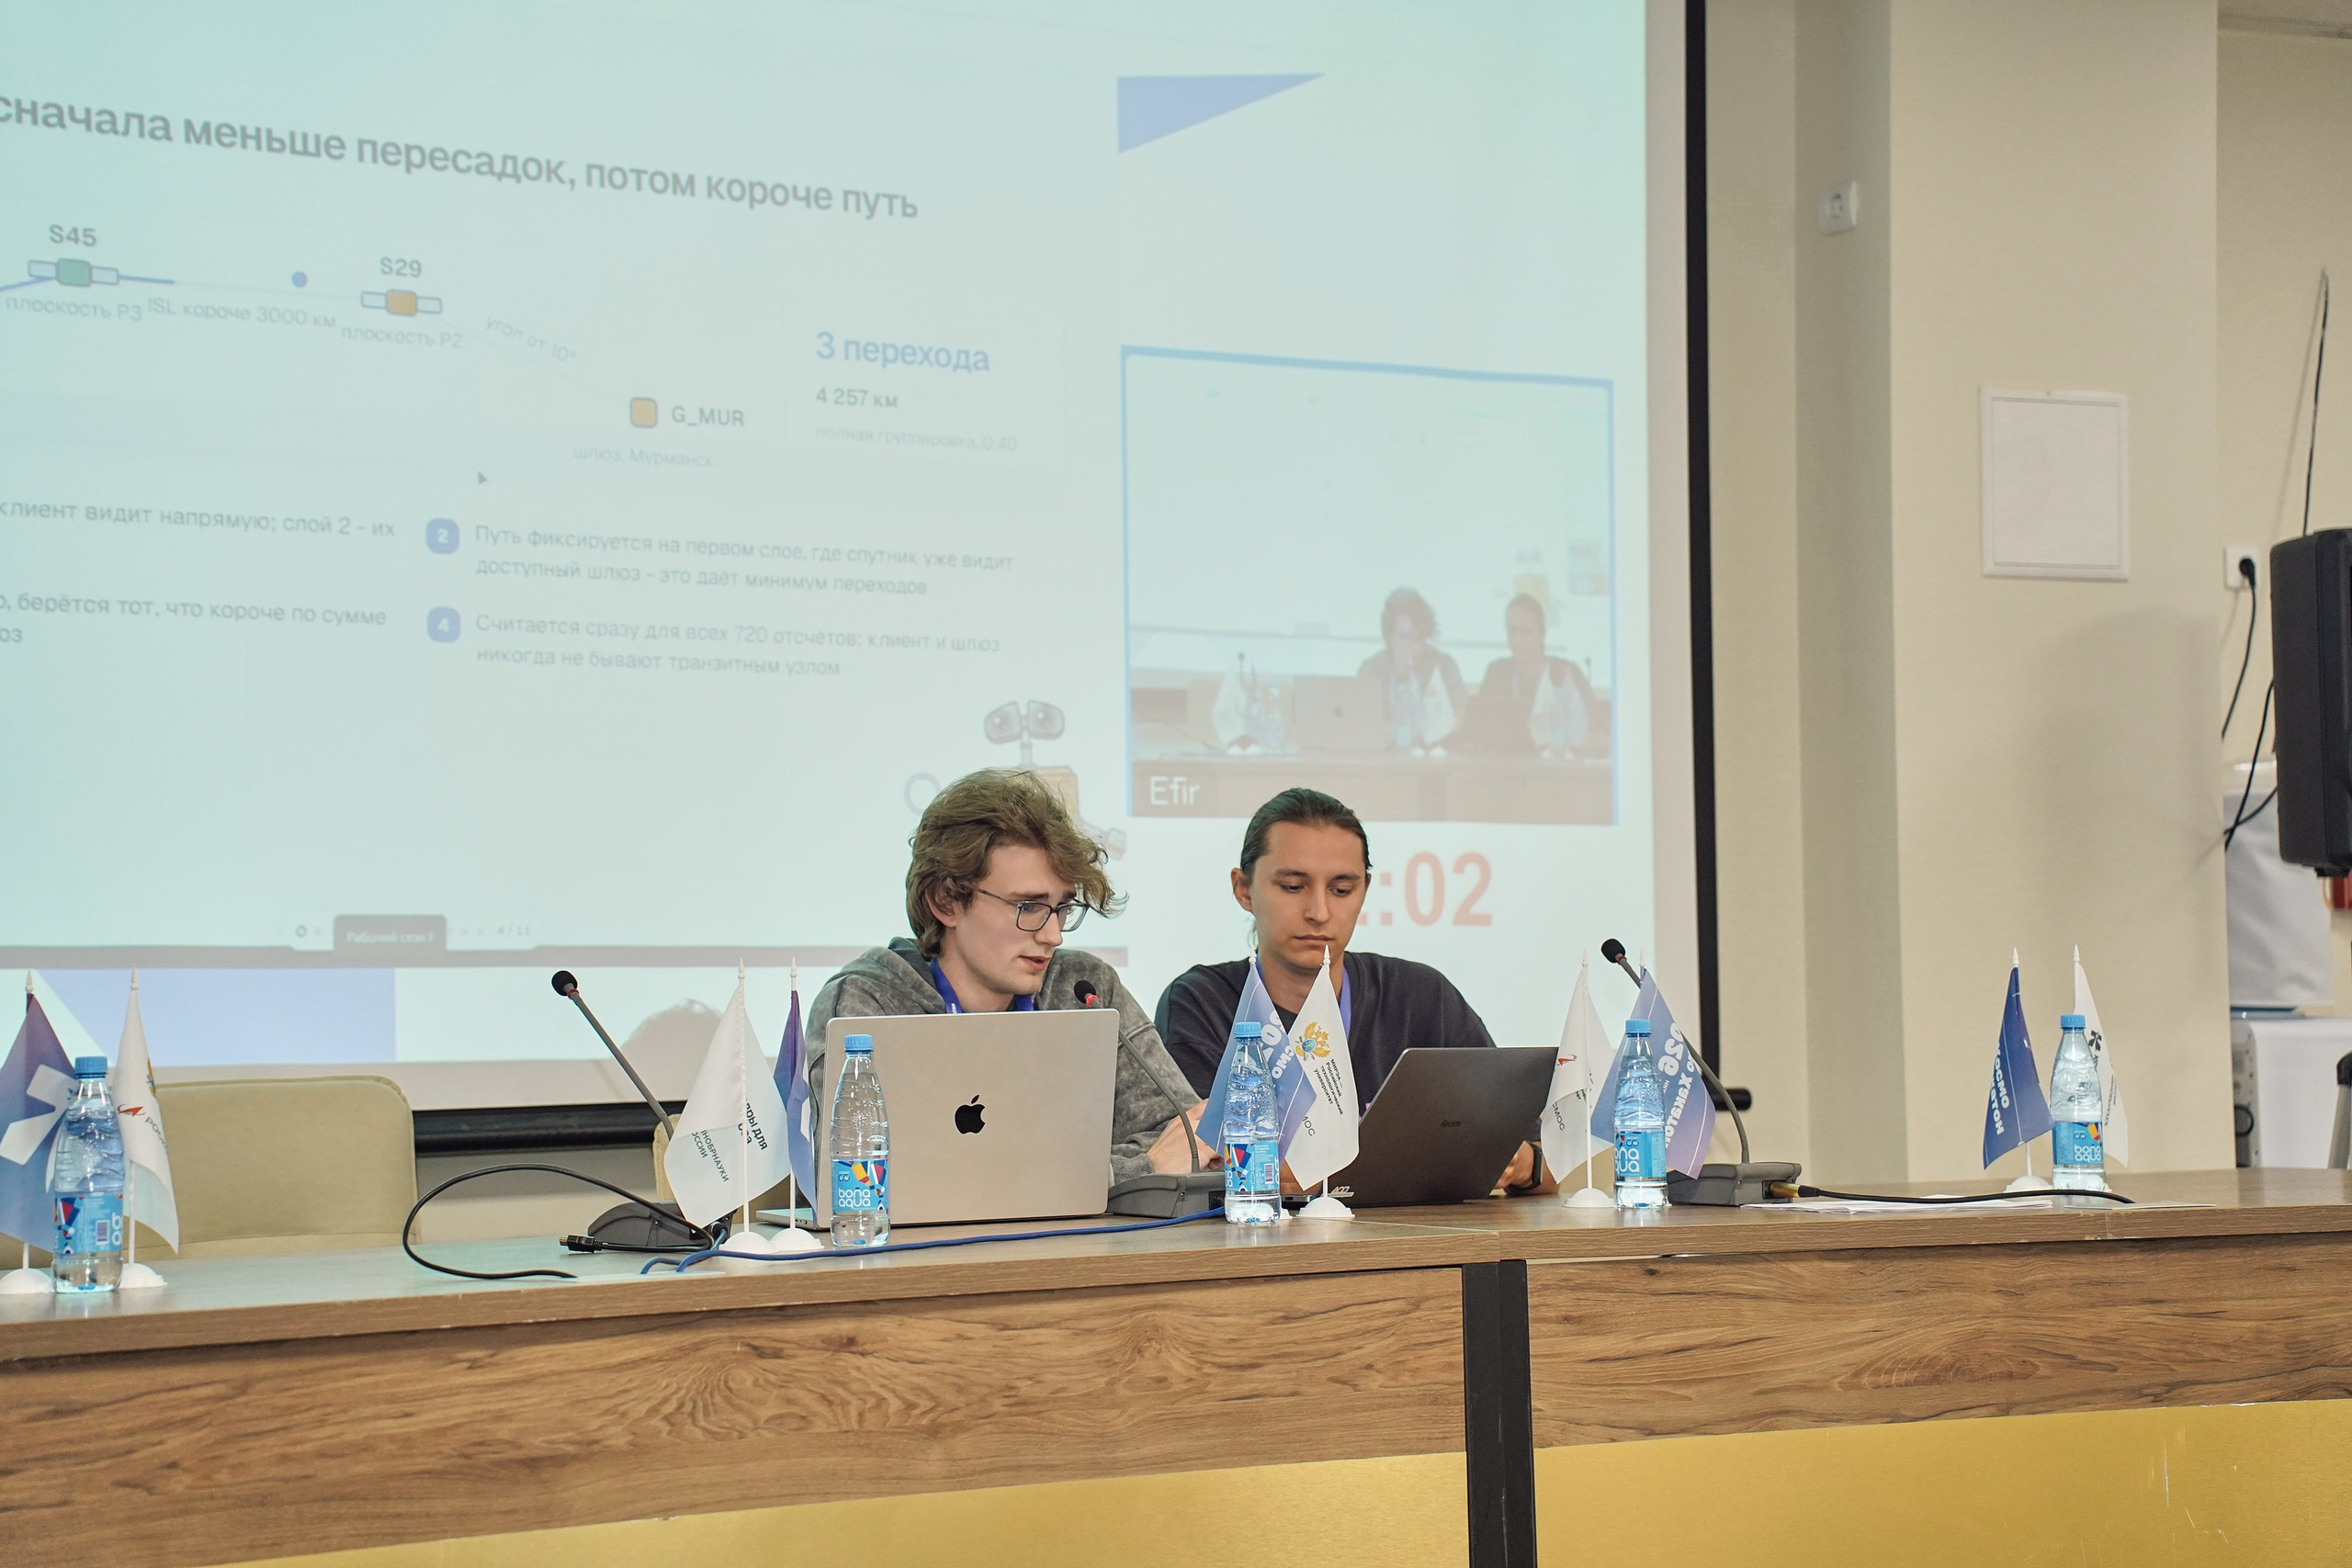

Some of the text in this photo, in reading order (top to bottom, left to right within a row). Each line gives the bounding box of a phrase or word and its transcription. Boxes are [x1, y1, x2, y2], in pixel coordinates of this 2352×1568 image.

[183, 118, 346, 161] меньше
[356, 137, 576, 191] пересадок,
[584, 162, 696, 198] потом
[706, 175, 832, 209] короче
[842, 188, 919, 220] путь
[49, 224, 97, 248] S45
[379, 257, 423, 278] S29
[6, 297, 111, 319] плоскость
[148, 298, 336, 328] ISL короче 3000 км
[341, 324, 435, 346] плоскость
[485, 316, 524, 342] угол
[526, 334, 547, 352] от
[816, 331, 990, 373] 3 перехода
[874, 393, 899, 408] км
[671, 405, 745, 427] G_MUR
[816, 426, 874, 442] полная
[629, 448, 715, 468] Мурманск
[85, 506, 152, 525] видит
[160, 510, 276, 533] напрямую;
[282, 512, 332, 534] слой
[338, 516, 351, 536] 2
[372, 522, 395, 537] их
[437, 528, 448, 544] 2
[475, 525, 522, 546] Путь
[527, 529, 653, 552] фиксируется
[658, 539, 680, 553] на
[686, 540, 754, 558] первом
[812, 547, 842, 562] где
[847, 547, 917, 567] спутник
[922, 553, 956, 568] уже
[962, 554, 1013, 570] видит
[475, 557, 581, 580] доступный
[587, 567, 640, 581] шлюз
[659, 570, 691, 584] это
[696, 570, 738, 586] даёт
[746, 574, 828, 592] минимум
[833, 576, 928, 595] переходов
[17, 592, 109, 614] берётся
[165, 601, 202, 618] что
[209, 603, 285, 623] короче
[291, 606, 316, 622] по
[322, 609, 387, 627] сумме
[437, 617, 449, 632] 4
[476, 614, 580, 635] Считается
[585, 621, 639, 640] сразу
[644, 625, 680, 640] для
[686, 627, 728, 641] всех
[735, 626, 768, 644] 720
[867, 634, 930, 649] клиент
[936, 638, 946, 649] и
[951, 638, 1001, 652] шлюз
[477, 647, 841, 677] никогда не бывают транзитным узлом
[1149, 775, 1200, 806] Efir
[1357, 851, 1493, 928] :02
[1314, 1068, 1333, 1105] университет
[1326, 1062, 1342, 1097] Российский
